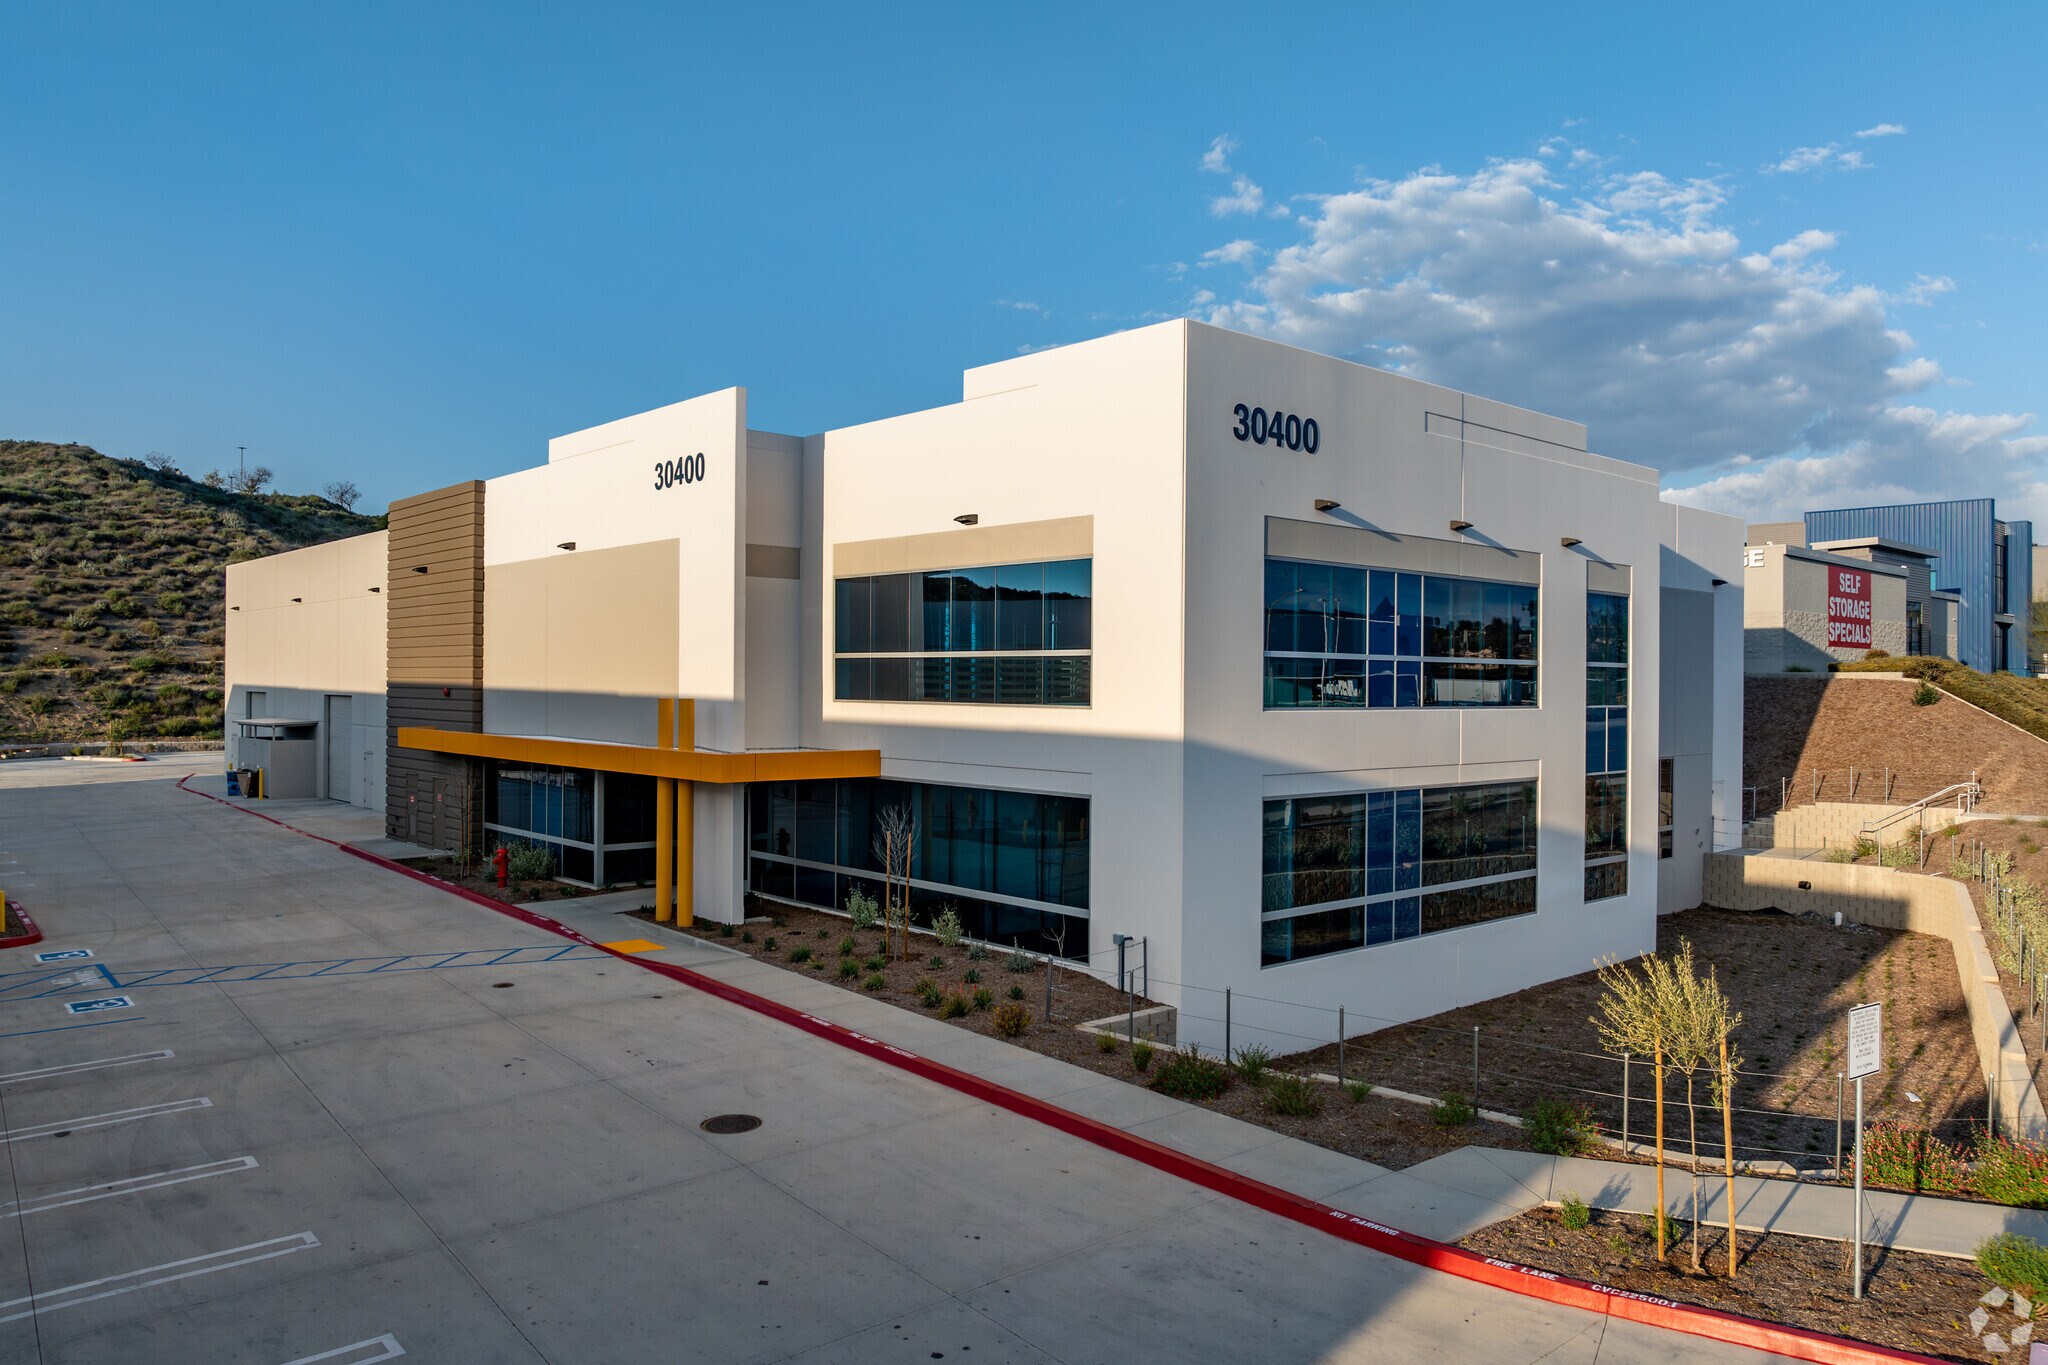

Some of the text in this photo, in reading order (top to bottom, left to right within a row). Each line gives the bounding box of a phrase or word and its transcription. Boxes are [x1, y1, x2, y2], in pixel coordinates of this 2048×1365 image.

[1233, 403, 1319, 455] 30400
[654, 452, 705, 491] 30400
[1839, 572, 1861, 595] SELF
[1829, 596, 1871, 620] STORAGE
[1828, 621, 1871, 644] SPECIALS
[1329, 1211, 1400, 1236] NO PARKING
[1484, 1257, 1516, 1270] FIRE
[1519, 1267, 1560, 1281] LANE
